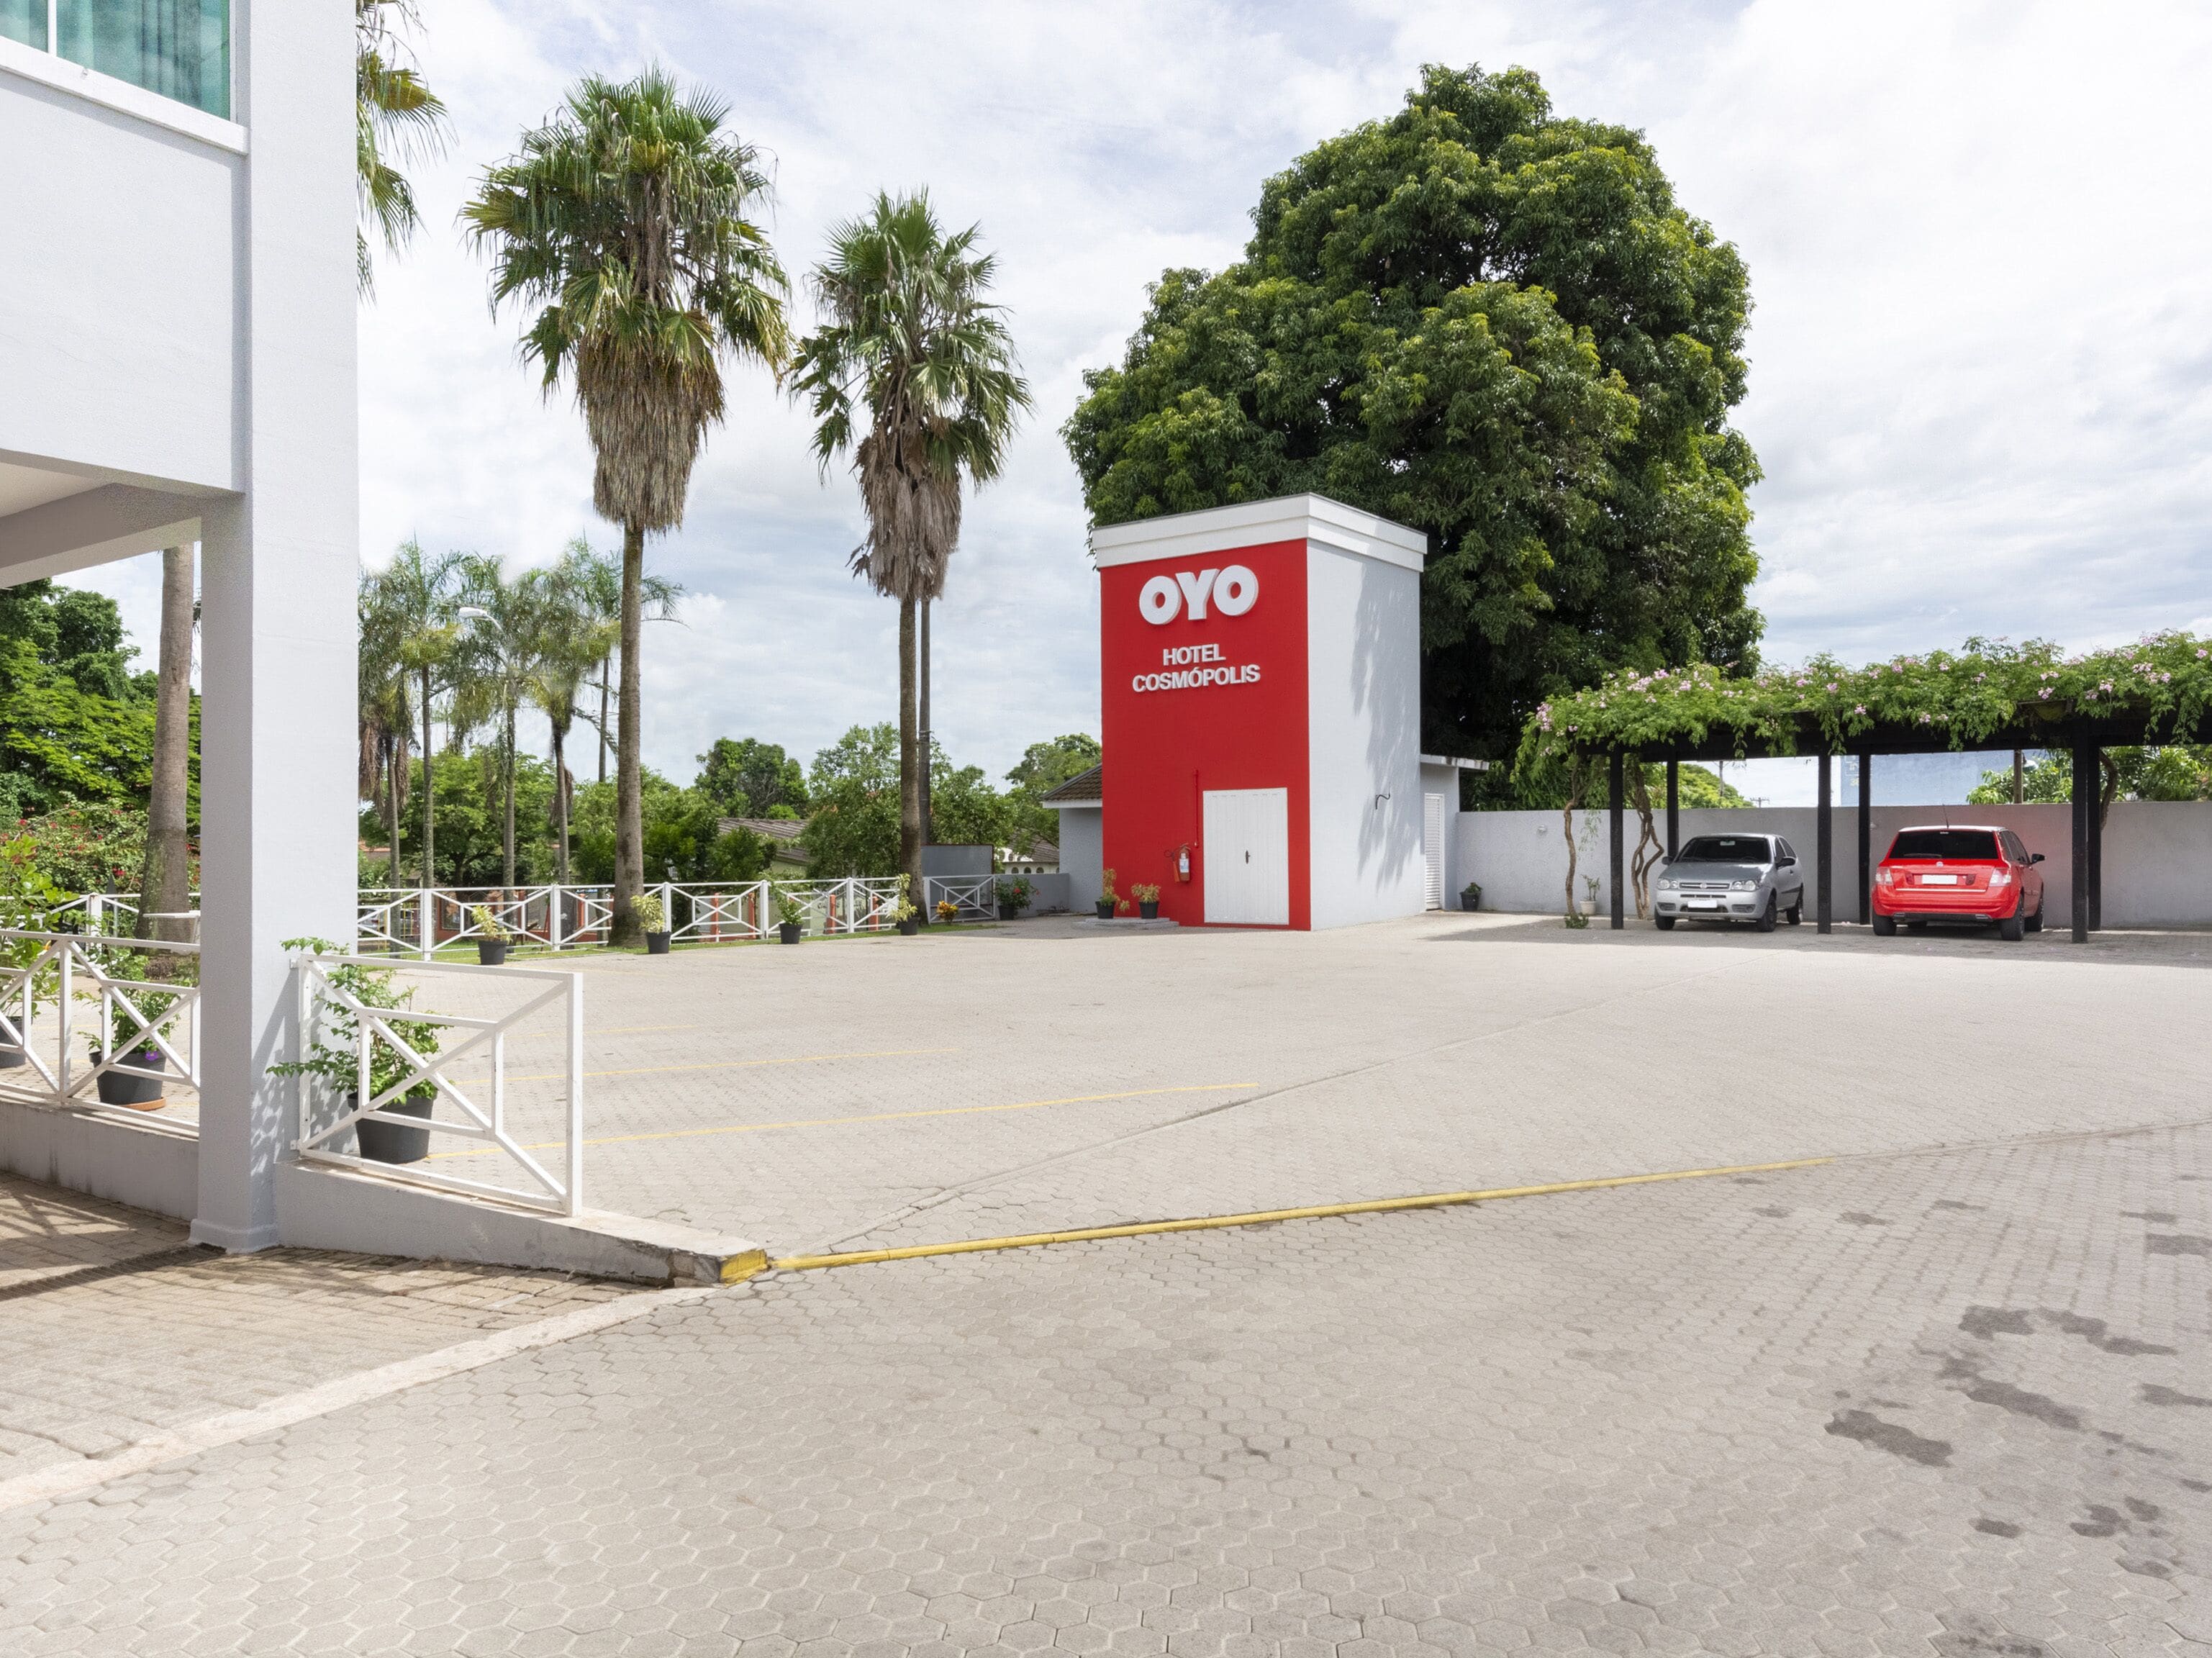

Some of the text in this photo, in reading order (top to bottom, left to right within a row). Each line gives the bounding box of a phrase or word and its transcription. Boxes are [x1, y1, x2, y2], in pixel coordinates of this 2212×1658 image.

[1139, 565, 1259, 625] OYO
[1163, 644, 1225, 666] HOTEL
[1133, 665, 1260, 692] COSMÓPOLIS
